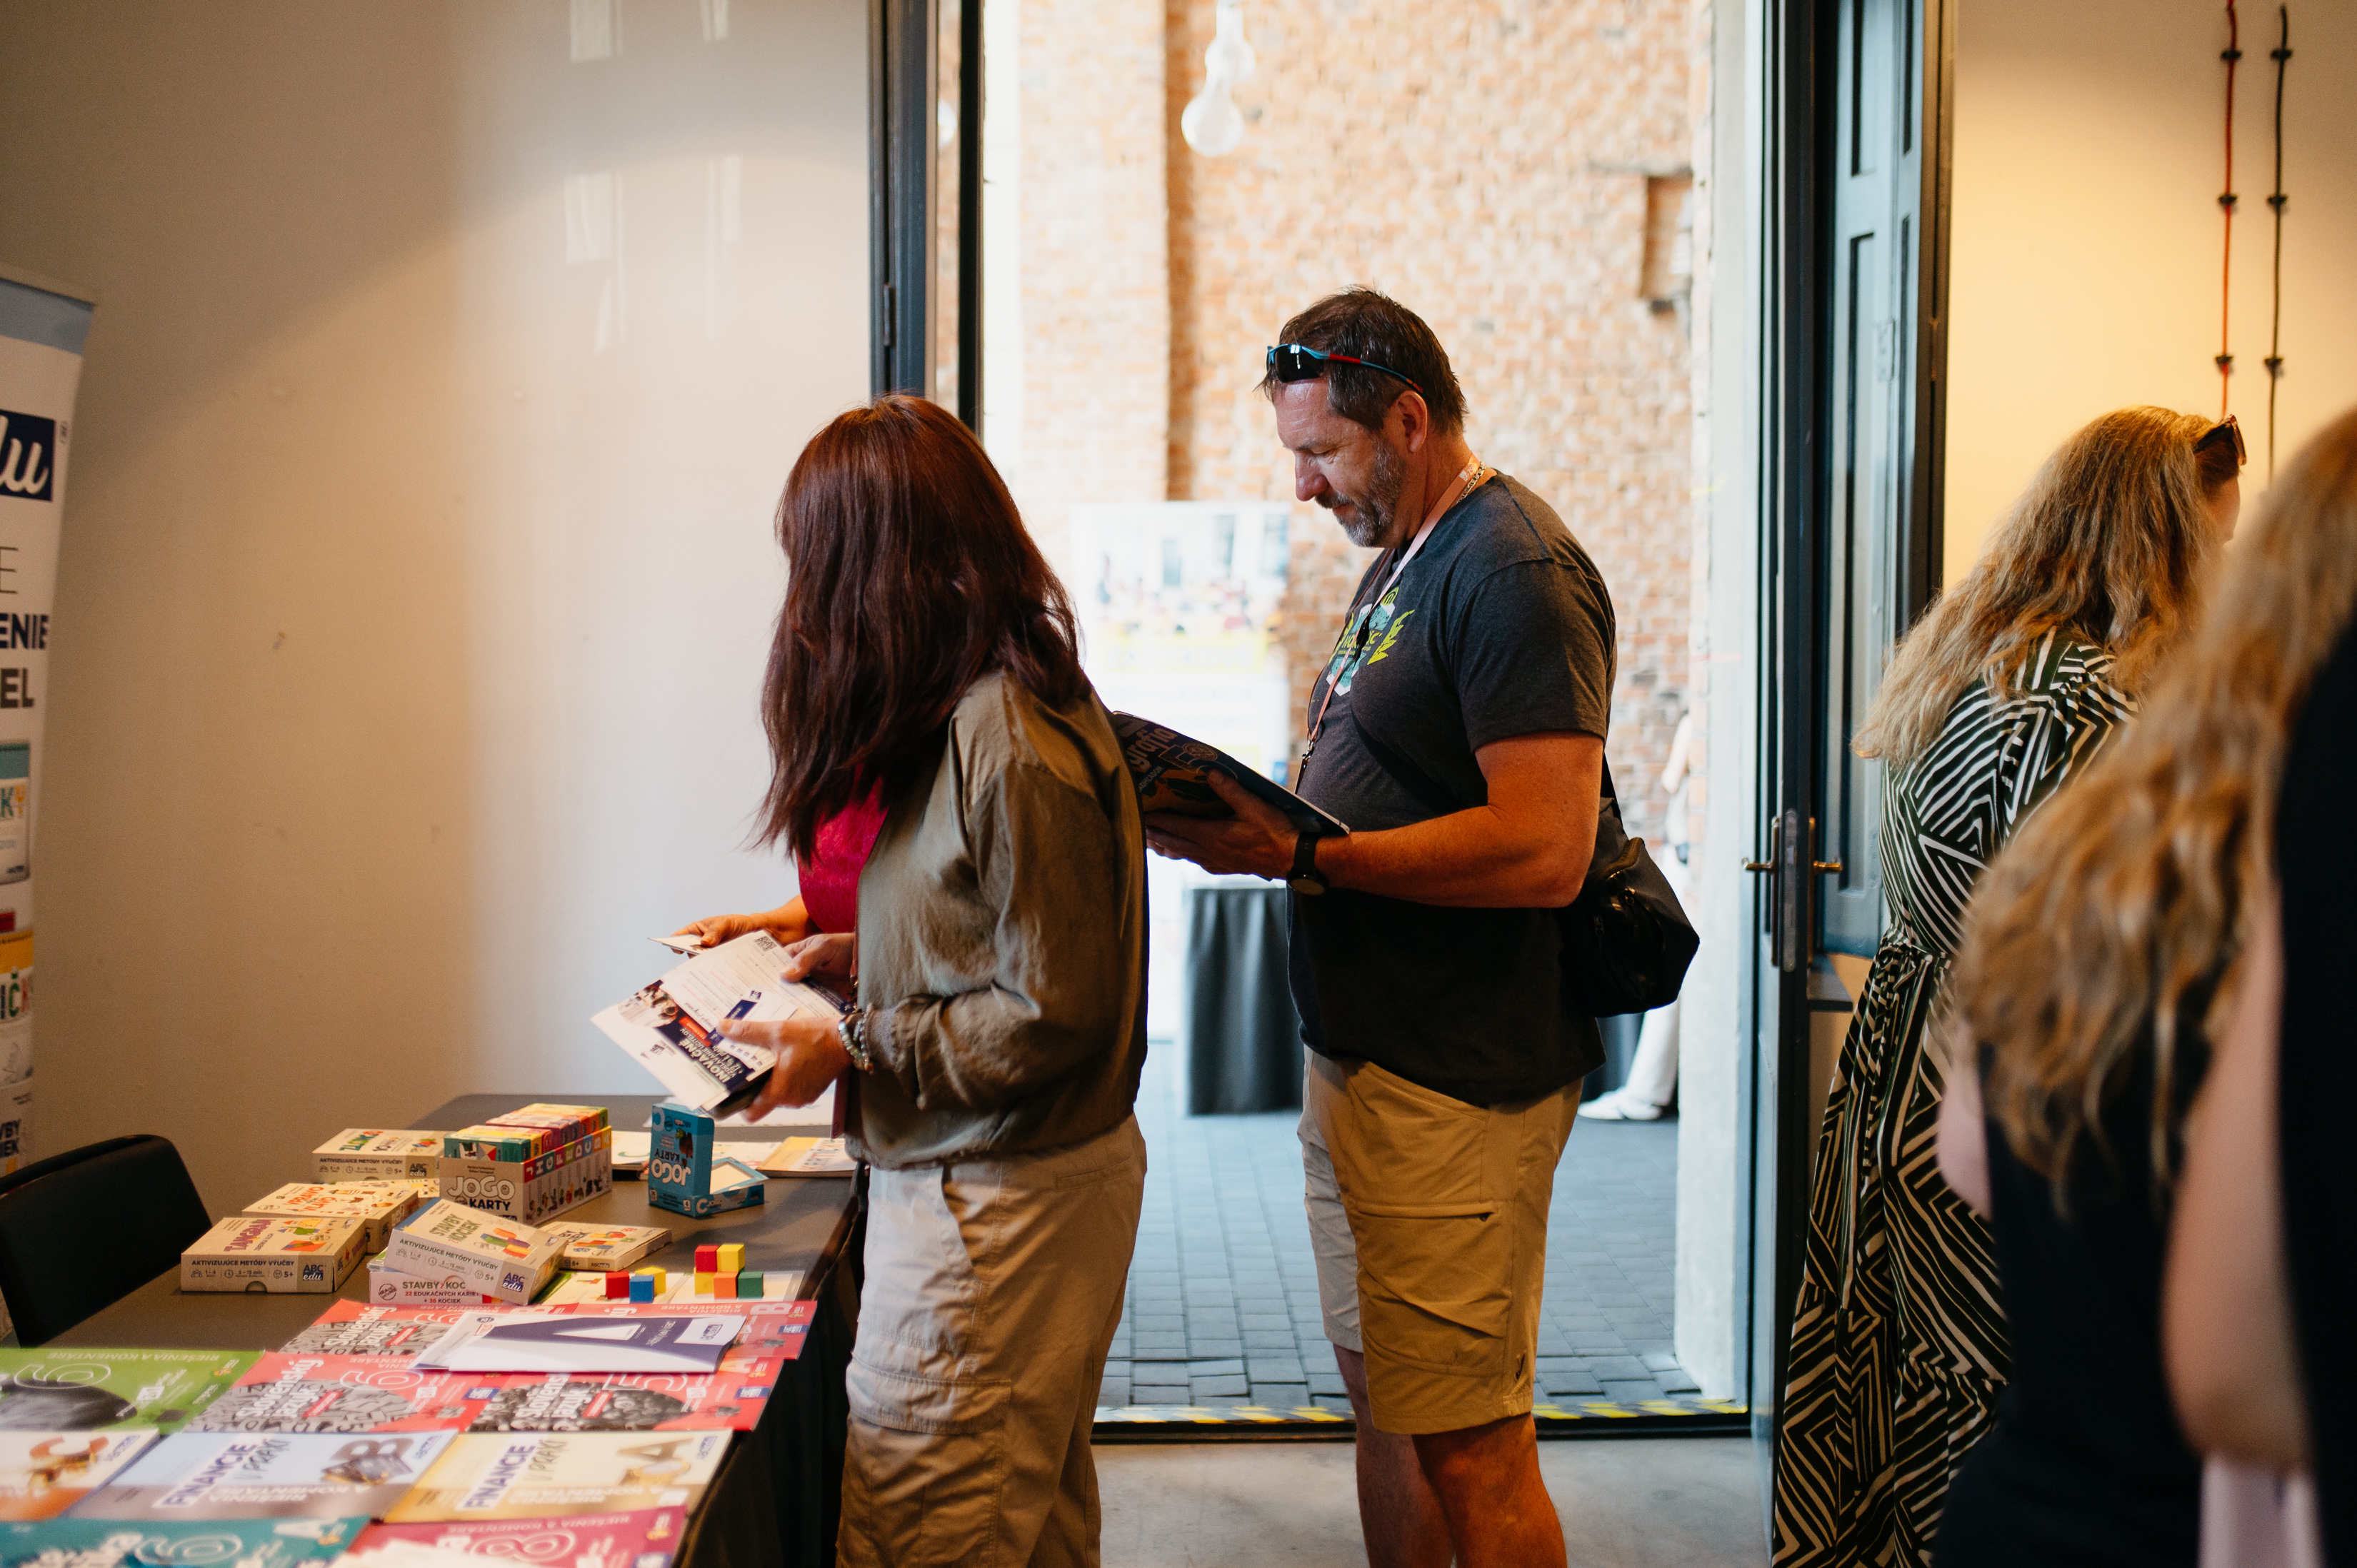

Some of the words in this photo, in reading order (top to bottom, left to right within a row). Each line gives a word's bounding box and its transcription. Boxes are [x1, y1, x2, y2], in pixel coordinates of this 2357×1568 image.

[678, 1037, 731, 1083] INOVAČNÉ
[654, 1147, 680, 1164] KARTY
[651, 1158, 691, 1187] JOGO
[446, 1175, 516, 1200] JOGO
[469, 1198, 511, 1212] KARTY
[223, 1219, 276, 1252] TANGRAM
[429, 1213, 465, 1237] STAVBY
[448, 1220, 482, 1242] KOCIEK
[399, 1238, 445, 1256] AKTIVIZUJÚCE
[445, 1252, 472, 1263] METÓDY
[473, 1258, 499, 1271] VÝUČBY
[303, 1272, 322, 1281] edu
[502, 1280, 522, 1292] edu
[503, 1272, 525, 1284] ABC
[324, 1306, 397, 1347] Slovenský
[236, 1359, 325, 1417] Slovenský
[339, 1370, 424, 1390] 6
[269, 1387, 321, 1419] jazyk
[514, 1374, 571, 1418] Slovens
[162, 1444, 259, 1505] FINANCIE
[464, 1445, 536, 1508] FINANCIE
